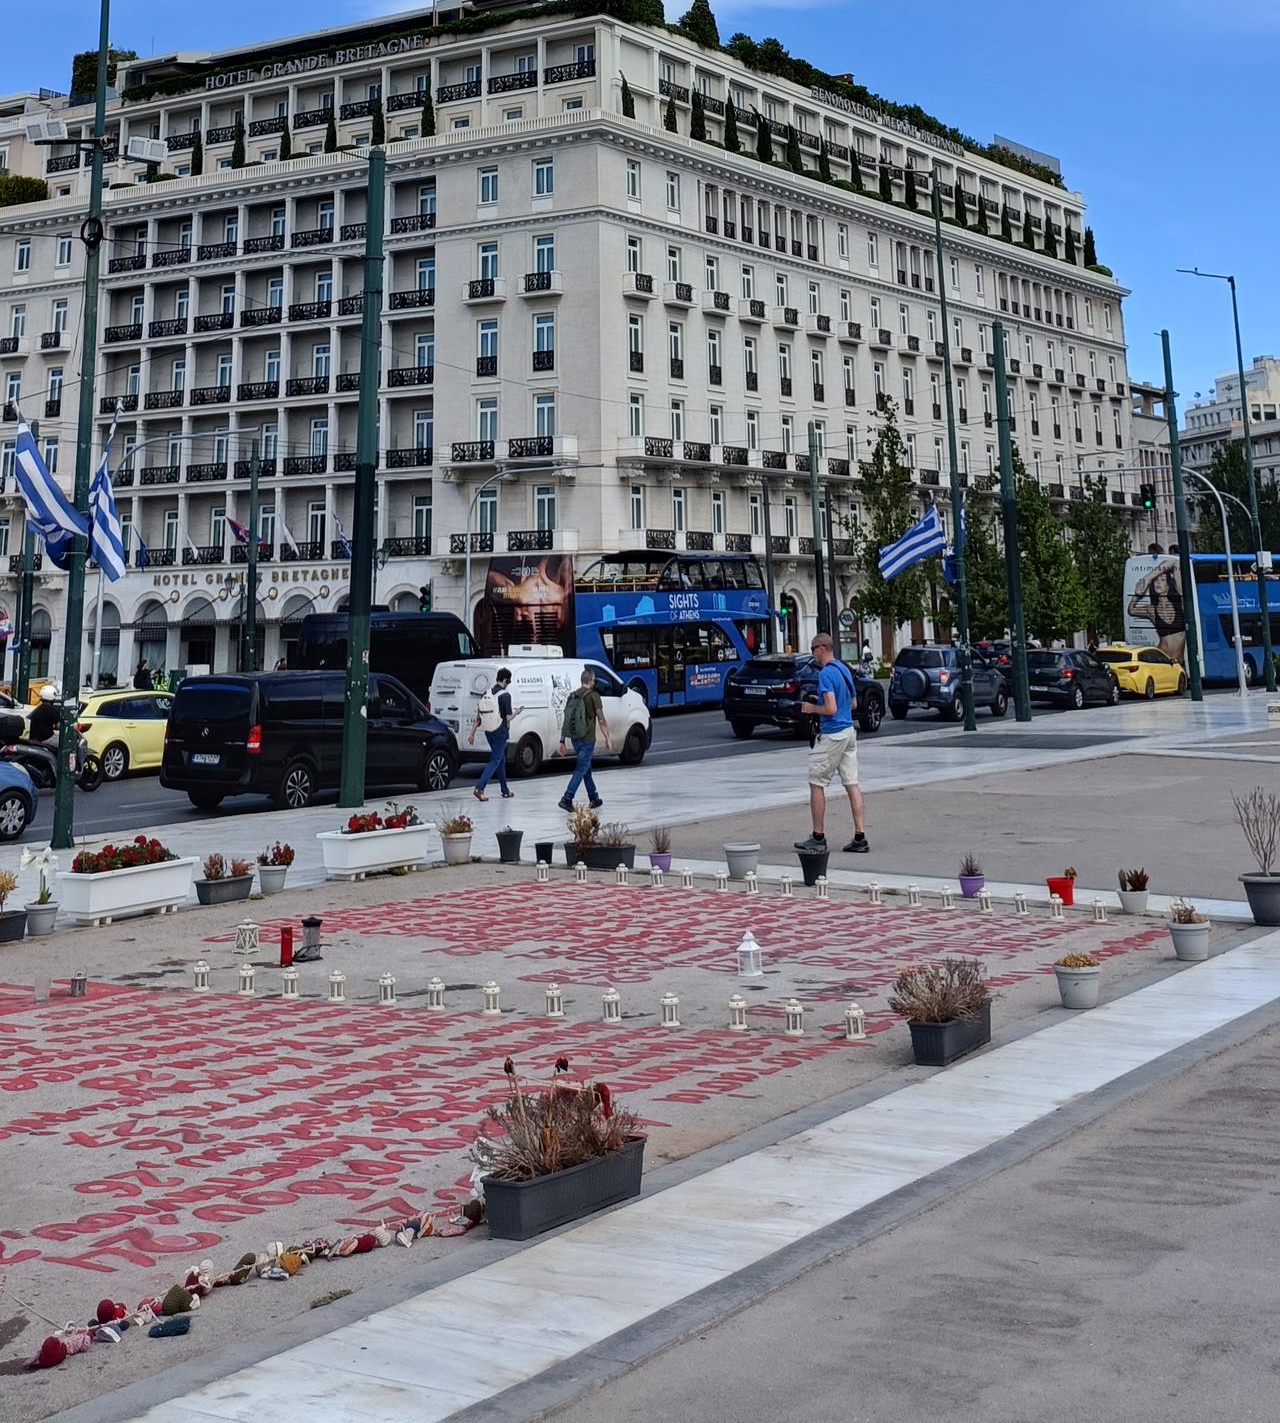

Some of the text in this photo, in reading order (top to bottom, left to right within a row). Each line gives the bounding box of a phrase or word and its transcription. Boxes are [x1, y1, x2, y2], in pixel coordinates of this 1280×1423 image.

[205, 35, 423, 90] HOTEL GRANDE BRETAGNE
[153, 572, 197, 586] HOTEL
[272, 568, 349, 583] BRETAGNE
[669, 593, 699, 609] SIGHTS
[669, 610, 678, 620] OF
[679, 609, 700, 620] ATHENS
